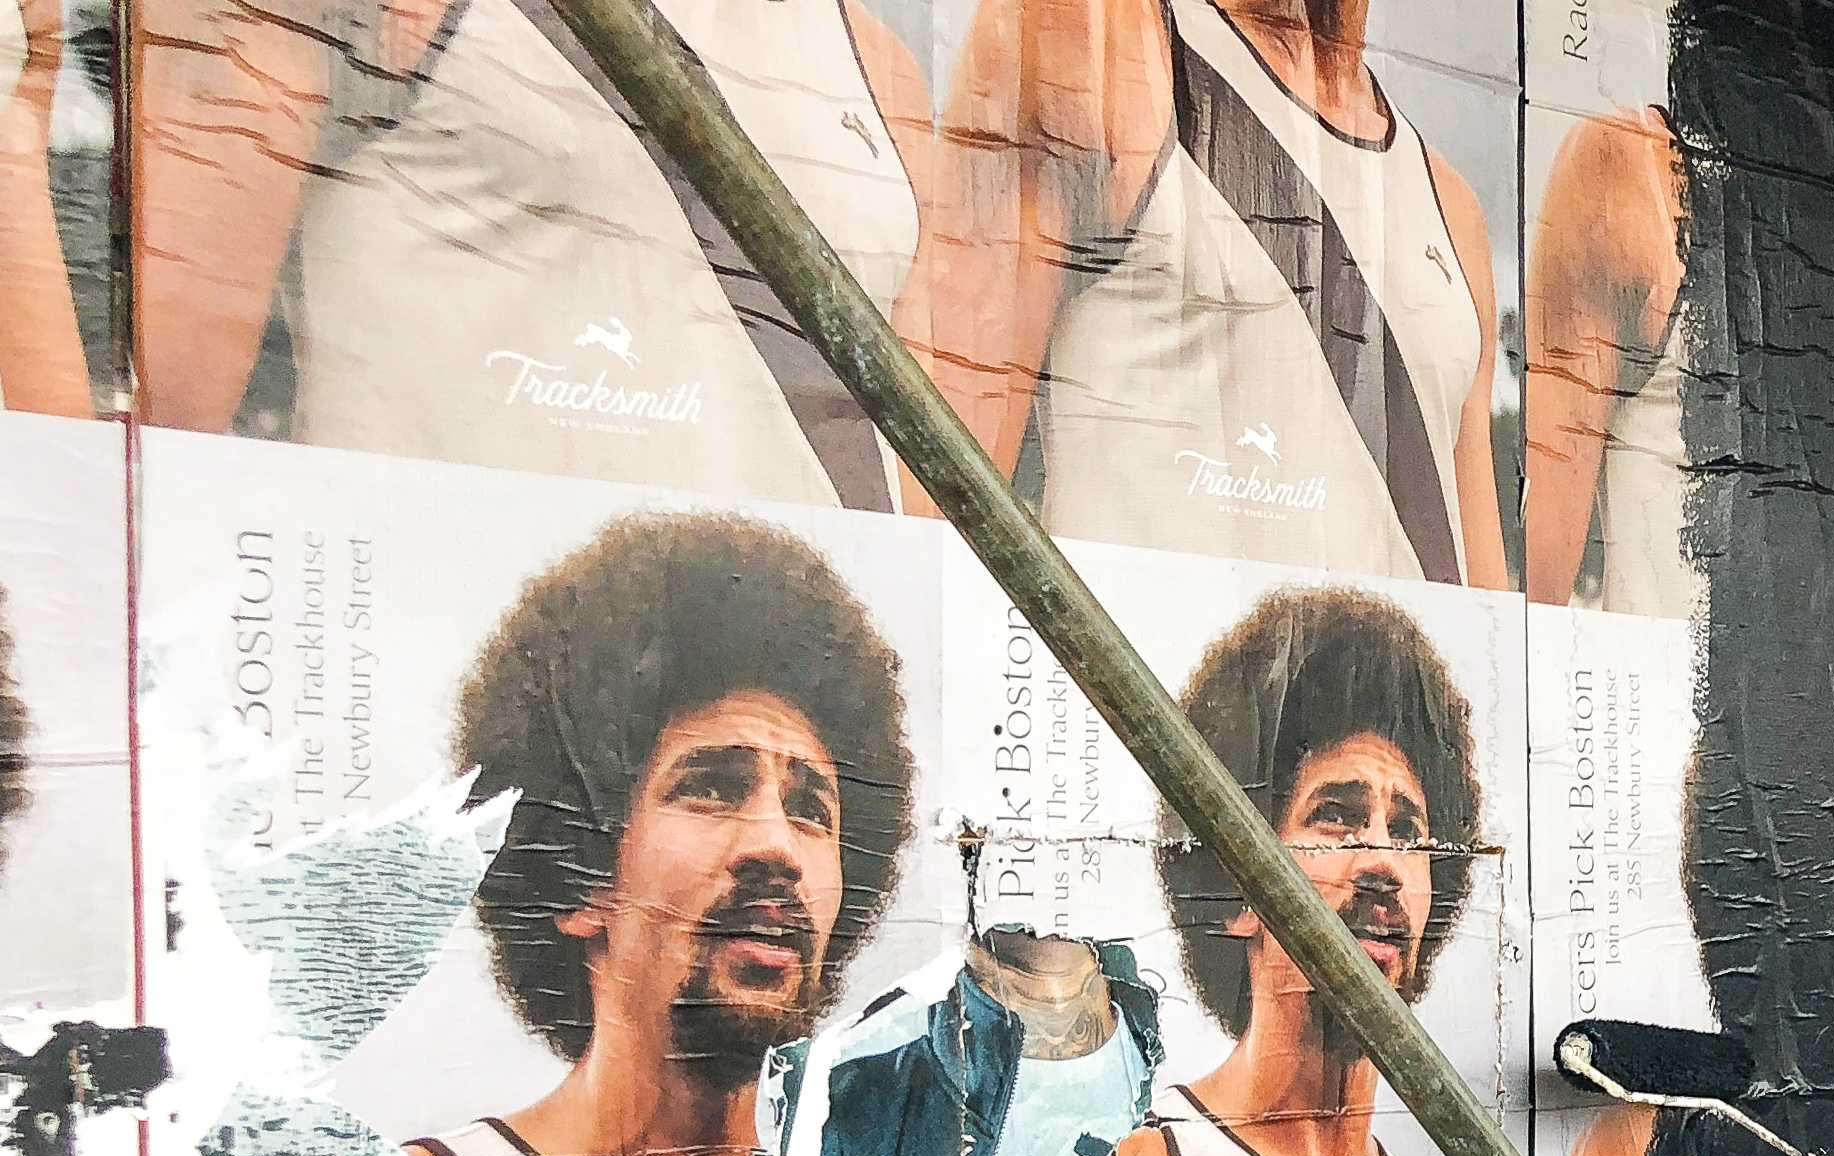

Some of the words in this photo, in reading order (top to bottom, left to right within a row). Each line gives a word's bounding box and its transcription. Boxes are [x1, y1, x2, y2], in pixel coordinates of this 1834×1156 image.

[1562, 0, 1588, 62] Ra
[486, 350, 702, 424] Tracksmith
[1174, 449, 1328, 511] Tracksmith
[344, 538, 372, 631] Street
[294, 530, 325, 726] Trackhouse
[343, 644, 380, 801] Newbury
[1046, 659, 1067, 765] Trackh
[1603, 668, 1619, 800] Trackhouse
[1625, 672, 1641, 737] Street
[1568, 668, 1595, 809] Boston
[294, 739, 325, 804] The
[1046, 773, 1067, 820] The
[1626, 744, 1645, 850] Newbury
[1603, 809, 1619, 854] The
[1054, 871, 1070, 900] us
[1568, 830, 1595, 913] Pick
[1606, 864, 1619, 882] at
[1607, 890, 1620, 915] us
[1626, 859, 1643, 901] 285
[1575, 931, 1597, 1015] cers
[1605, 924, 1621, 965] Join
